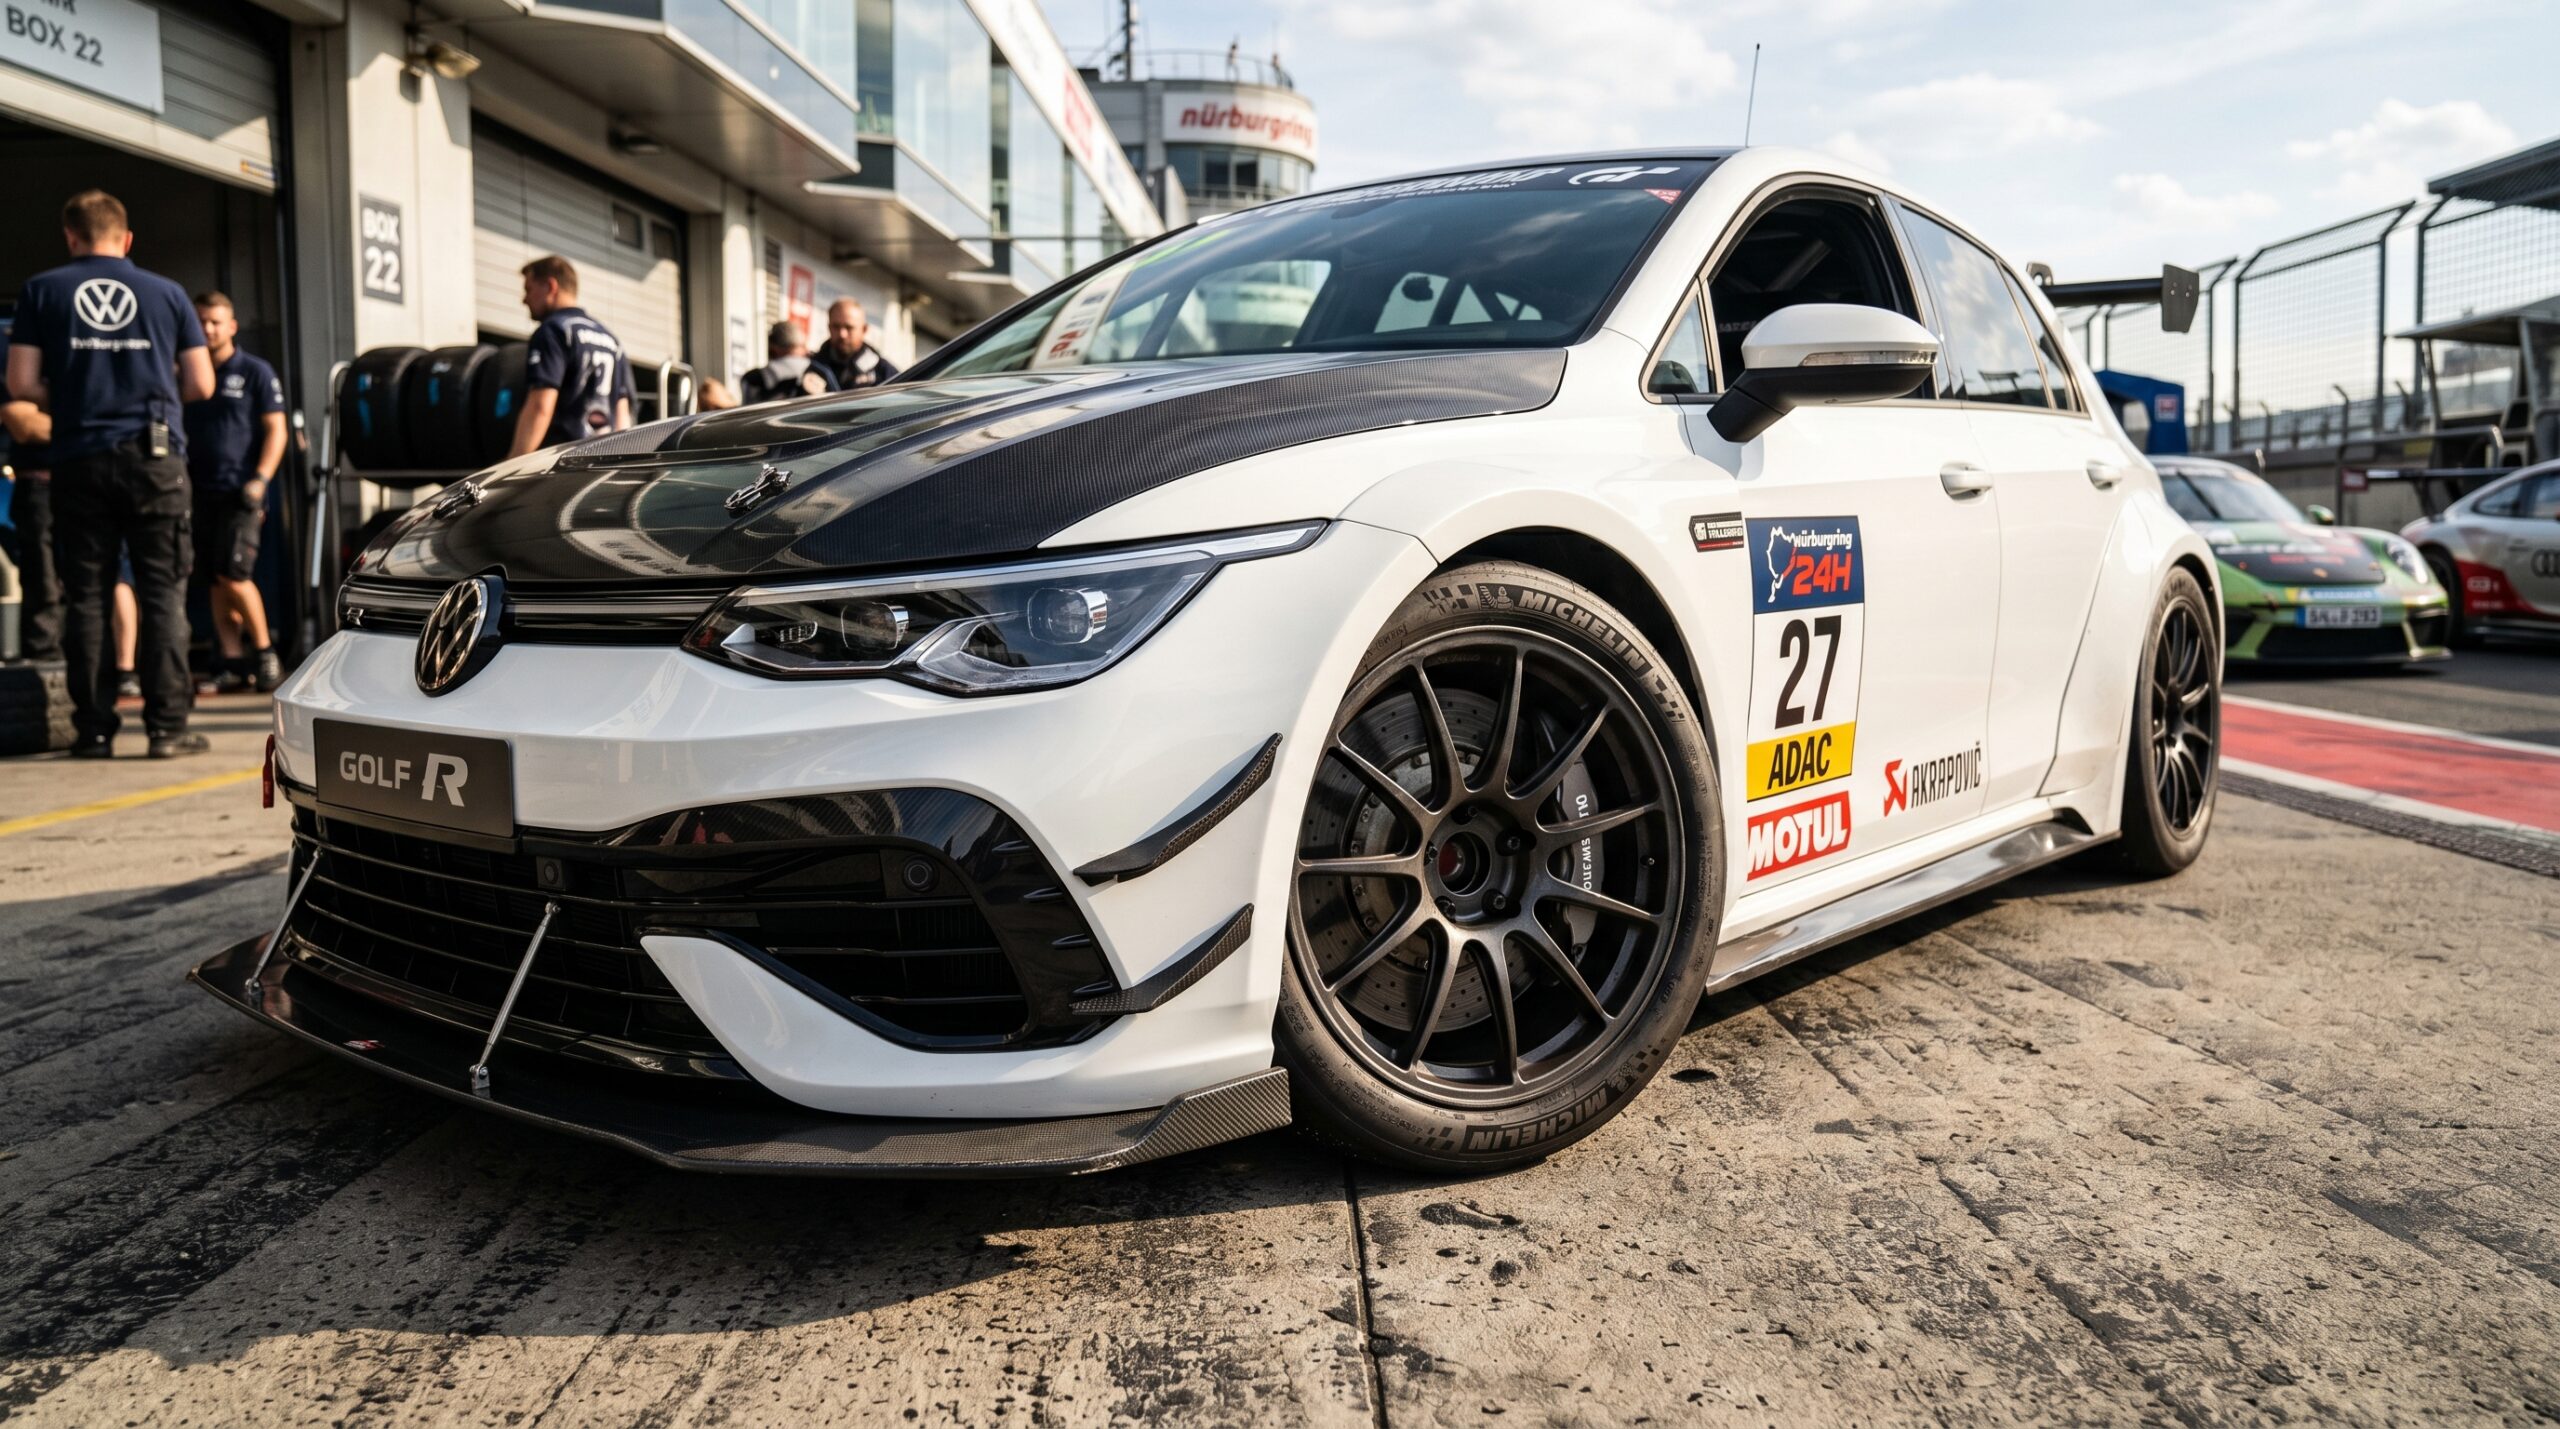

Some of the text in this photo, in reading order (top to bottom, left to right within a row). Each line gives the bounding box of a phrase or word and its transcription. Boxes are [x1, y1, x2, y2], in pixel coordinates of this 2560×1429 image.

[6, 5, 104, 67] BOX 22
[1180, 102, 1313, 147] nürburgring
[363, 207, 400, 245] BOX
[365, 246, 401, 294] 22
[1792, 552, 1852, 596] 24H
[1520, 590, 1648, 672] MICHELIN
[1775, 615, 1842, 729] 27
[339, 751, 469, 808] GOLF R
[1767, 732, 1832, 790] ADAC
[1748, 801, 1848, 875] MOTUL
[1469, 1087, 1608, 1150] MICHELIN
